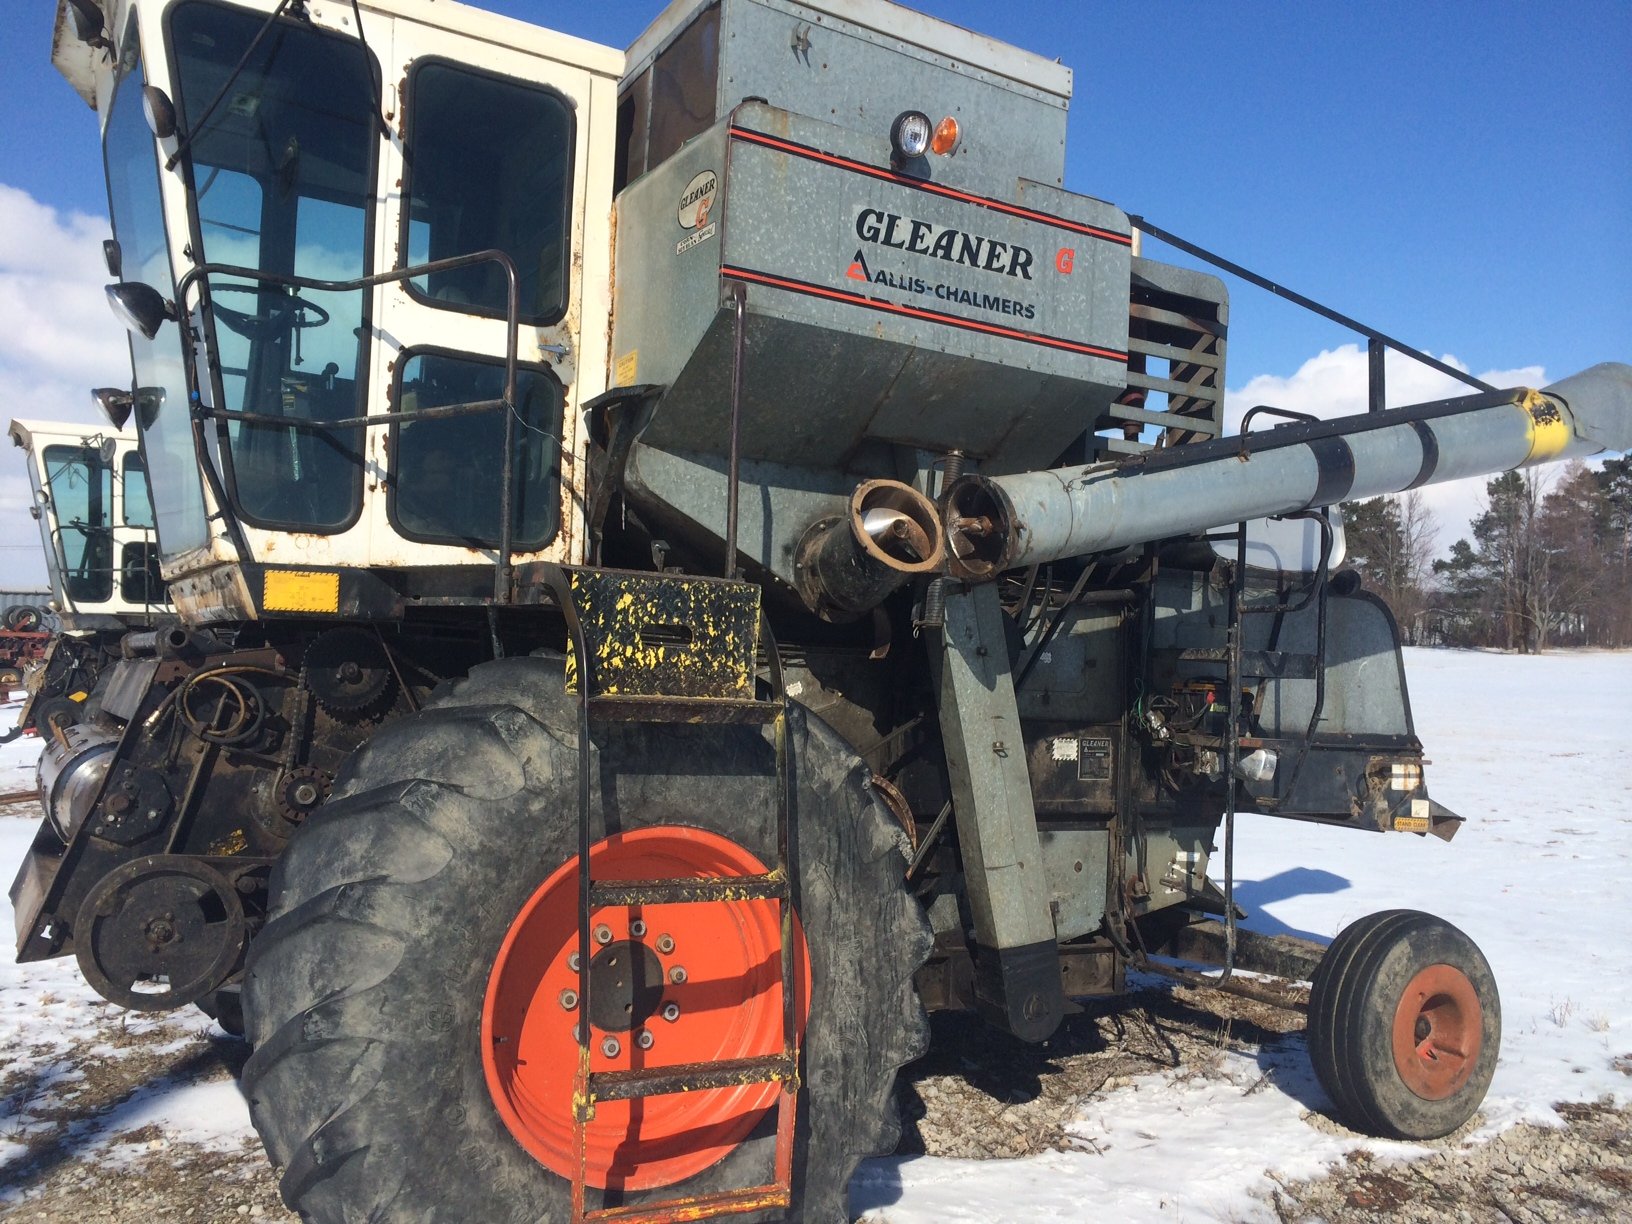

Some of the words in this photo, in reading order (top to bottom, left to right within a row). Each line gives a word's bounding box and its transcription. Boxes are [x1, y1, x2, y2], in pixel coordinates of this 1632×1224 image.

[680, 178, 715, 210] GLEANER
[696, 197, 709, 229] G
[856, 208, 1034, 280] GLEANER
[1056, 247, 1075, 275] G
[874, 269, 1035, 320] ALLIS-CHALMERS
